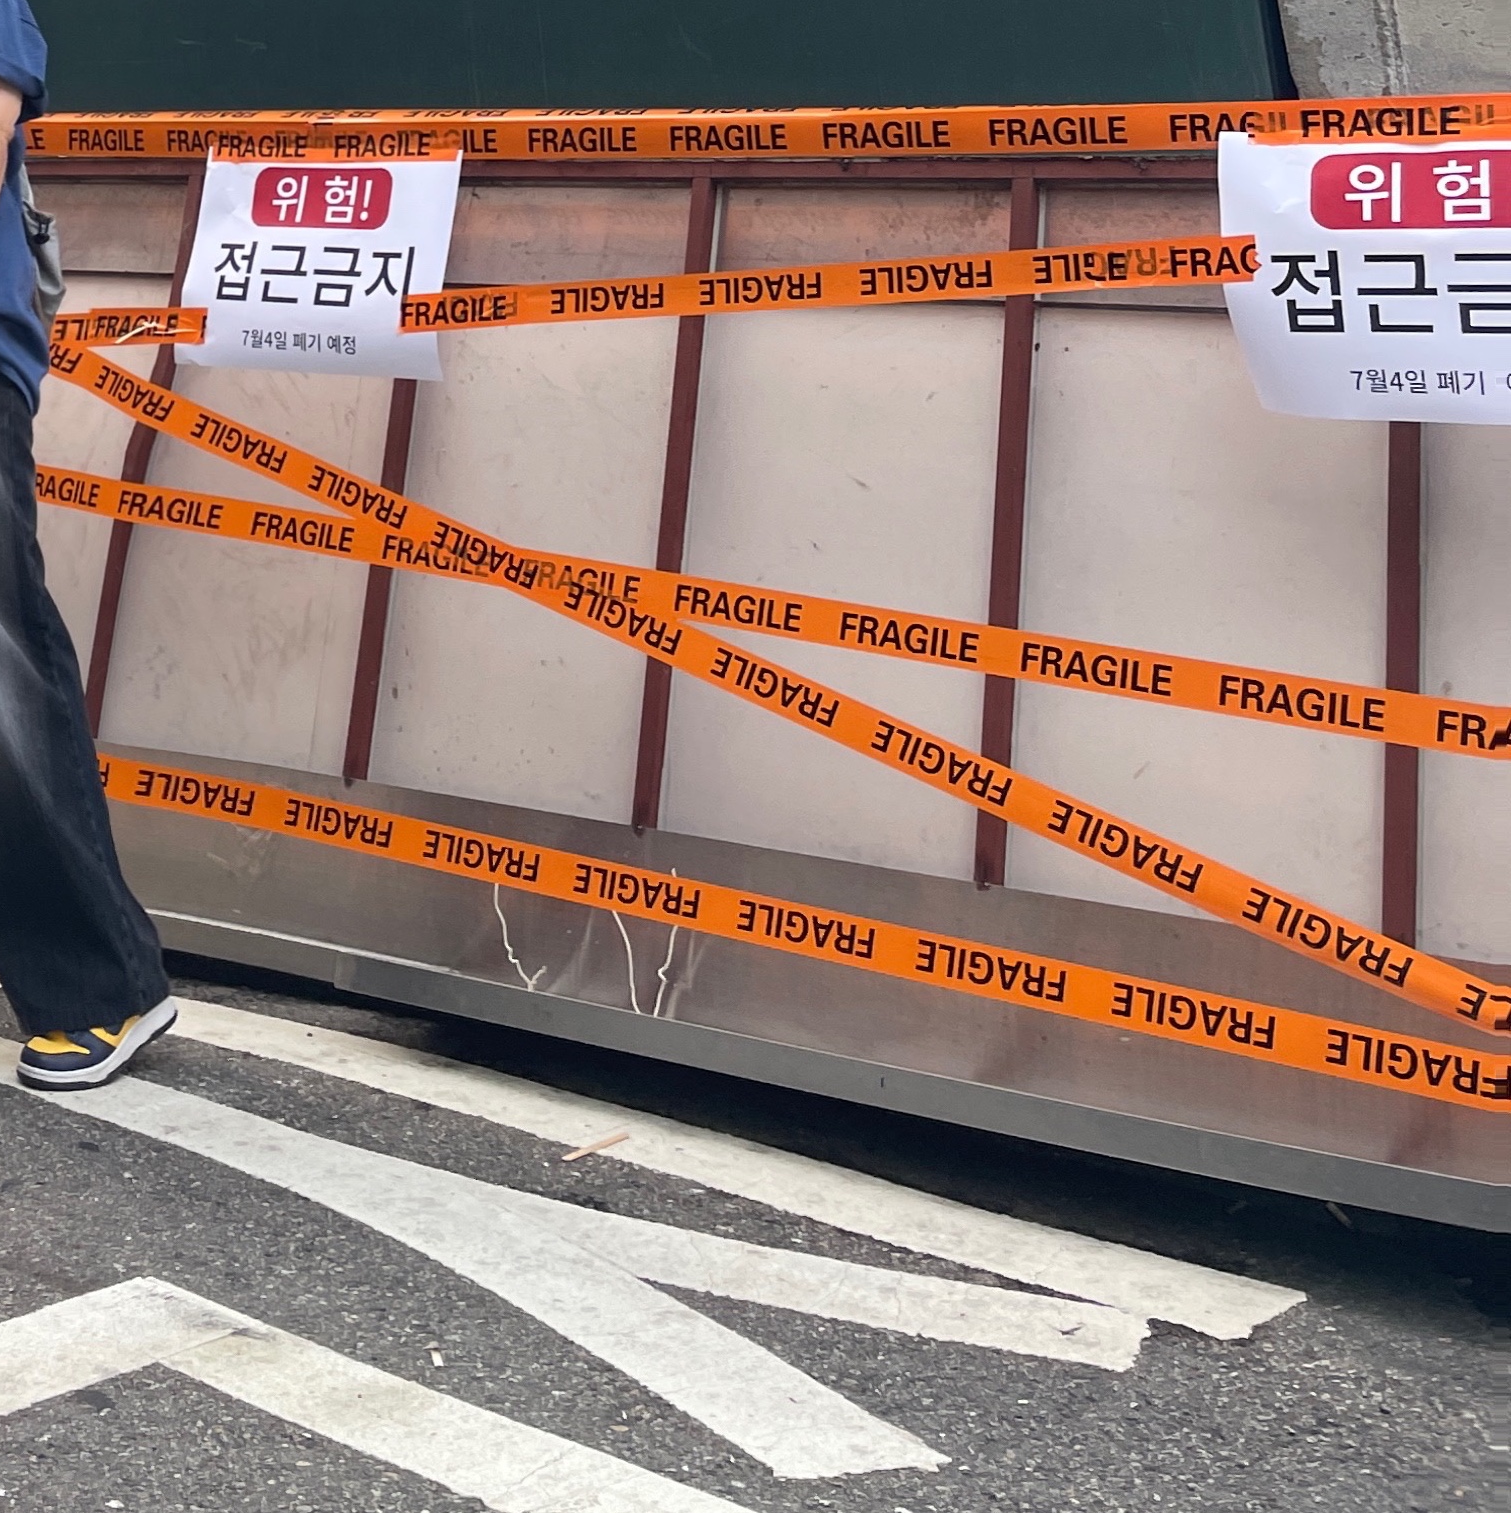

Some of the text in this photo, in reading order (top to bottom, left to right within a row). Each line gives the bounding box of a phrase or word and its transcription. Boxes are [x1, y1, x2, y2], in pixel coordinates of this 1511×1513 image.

[69, 129, 145, 152] FRAGILE
[217, 134, 307, 158] FRAGILE
[335, 133, 430, 158] FRAGILE
[529, 128, 636, 153] FRAGILE
[669, 124, 787, 151] FRAGILE
[822, 120, 950, 150] FRAGILE
[989, 116, 1128, 147] FRAGILE
[1301, 106, 1461, 138] FRAGILE
[214, 239, 416, 308] 접근금지
[401, 294, 508, 327] FRAGILE
[550, 282, 665, 315] FRAGILE
[699, 271, 822, 306] FRAGILE
[860, 260, 993, 296] FRAGILE
[241, 328, 357, 355] 7월4일 폐기 예정
[1350, 370, 1428, 395] 7월4일
[36, 472, 101, 509] RAGILE
[117, 488, 223, 531] FRAGILE
[250, 511, 355, 553] FRAGILE
[673, 584, 803, 633] FRAGILE
[839, 612, 980, 663] FRAGILE
[1020, 642, 1173, 697] FRAGILE
[1218, 674, 1386, 732] FRAGILE
[95, 365, 1413, 988] FRAGILE FRAGILE FRAGILE FRAGILE FRAGILE FRAGILE FRAGILE FRAGILE FRAGILE
[135, 768, 256, 817] FRAGILE
[284, 798, 393, 848] FRAGILE
[423, 829, 540, 882] FRAGILE
[574, 864, 701, 919] FRAGILE
[737, 899, 876, 958] FRAGILE
[915, 939, 1068, 1002] FRAGILE
[1111, 982, 1276, 1049] FRAGILE
